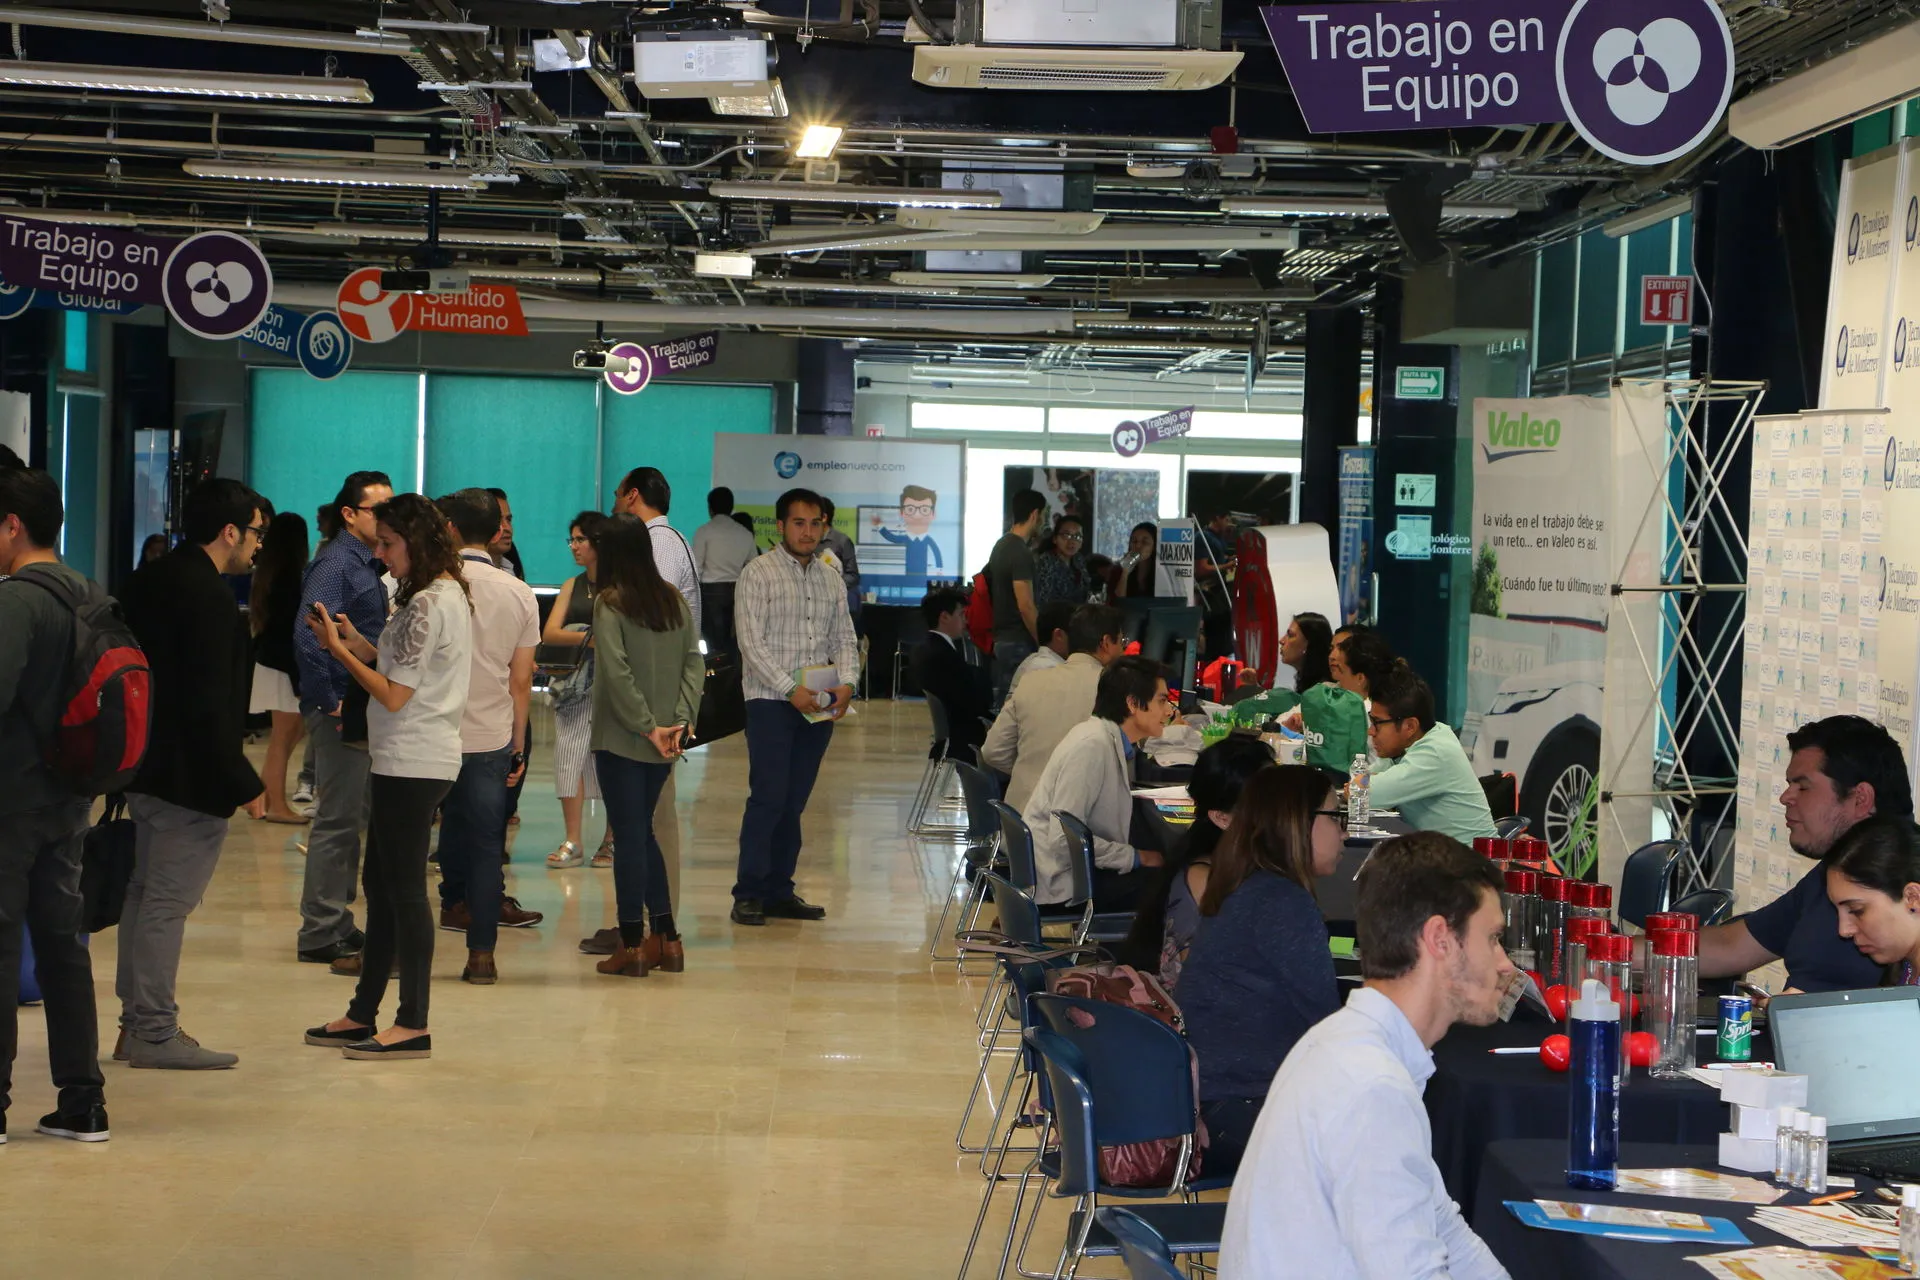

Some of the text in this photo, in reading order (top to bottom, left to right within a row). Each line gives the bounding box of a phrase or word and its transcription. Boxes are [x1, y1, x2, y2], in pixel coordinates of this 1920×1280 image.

[1297, 10, 1544, 68] Trabajo en
[1362, 63, 1519, 122] Equipo
[5, 220, 159, 266] Trabajo en
[40, 254, 139, 295] Equipo
[1648, 280, 1687, 290] EXTINTOR
[425, 288, 505, 308] Sentido
[420, 307, 508, 331] Humano
[651, 335, 714, 358] Trabajo en
[669, 351, 709, 369] Equipo
[1144, 409, 1191, 429] Trabajo en
[1488, 410, 1561, 447] Valeo
[1157, 422, 1188, 438] Equipo
[807, 459, 906, 473] empleonuevo.com
[1483, 513, 1492, 526] La
[1495, 514, 1513, 528] vida
[1516, 518, 1528, 528] en
[1530, 514, 1539, 528] el
[1543, 513, 1575, 531] trabajo
[1577, 513, 1594, 530] debe
[1493, 535, 1504, 546] un
[1507, 535, 1533, 548] reto...
[1536, 537, 1549, 548] en
[1552, 533, 1575, 548] Valeo
[1577, 538, 1586, 549] es
[1160, 543, 1192, 561] MAXION
[1500, 576, 1535, 592] ¿Cuándo
[1539, 576, 1553, 592] fue
[1556, 578, 1565, 591] tu
[1567, 577, 1592, 594] último
[1725, 1022, 1752, 1040] Spri
